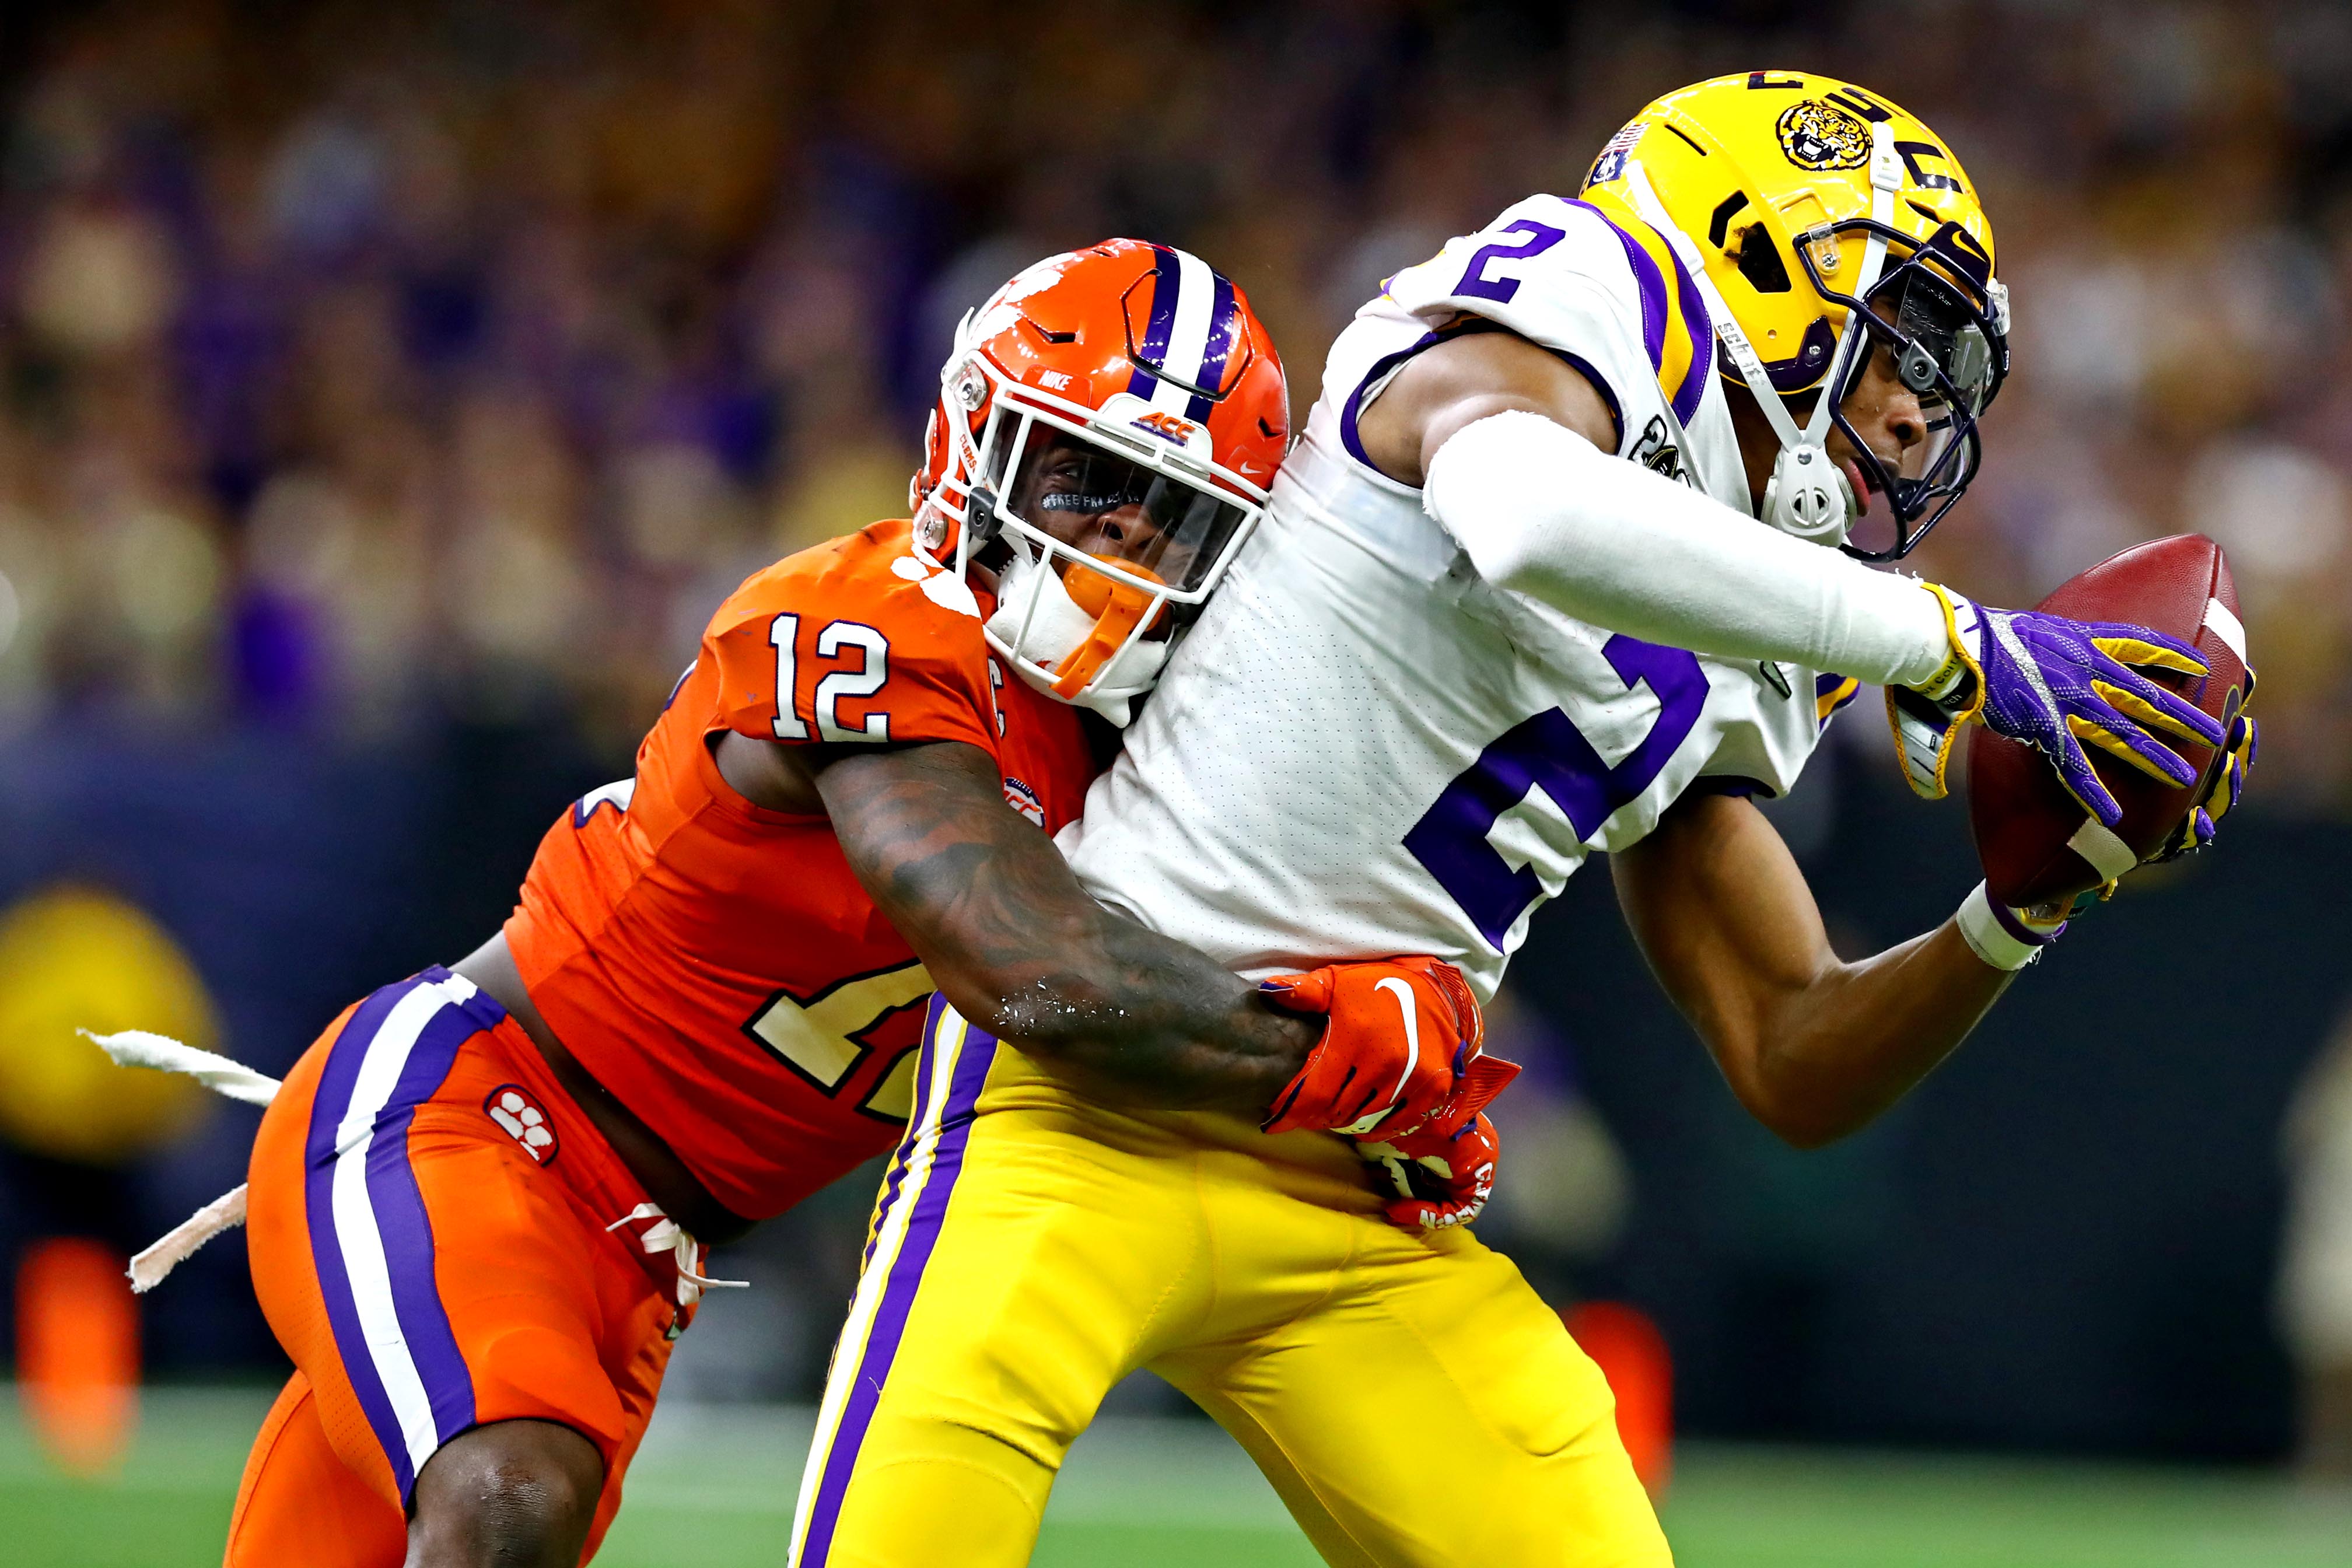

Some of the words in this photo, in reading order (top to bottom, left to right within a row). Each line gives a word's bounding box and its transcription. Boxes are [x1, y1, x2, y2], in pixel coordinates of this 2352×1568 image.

[1450, 219, 1566, 304] 2
[1038, 370, 1073, 391] NIKE
[1138, 411, 1195, 439] ACC
[769, 611, 891, 743] 12
[1402, 634, 1710, 957] 2
